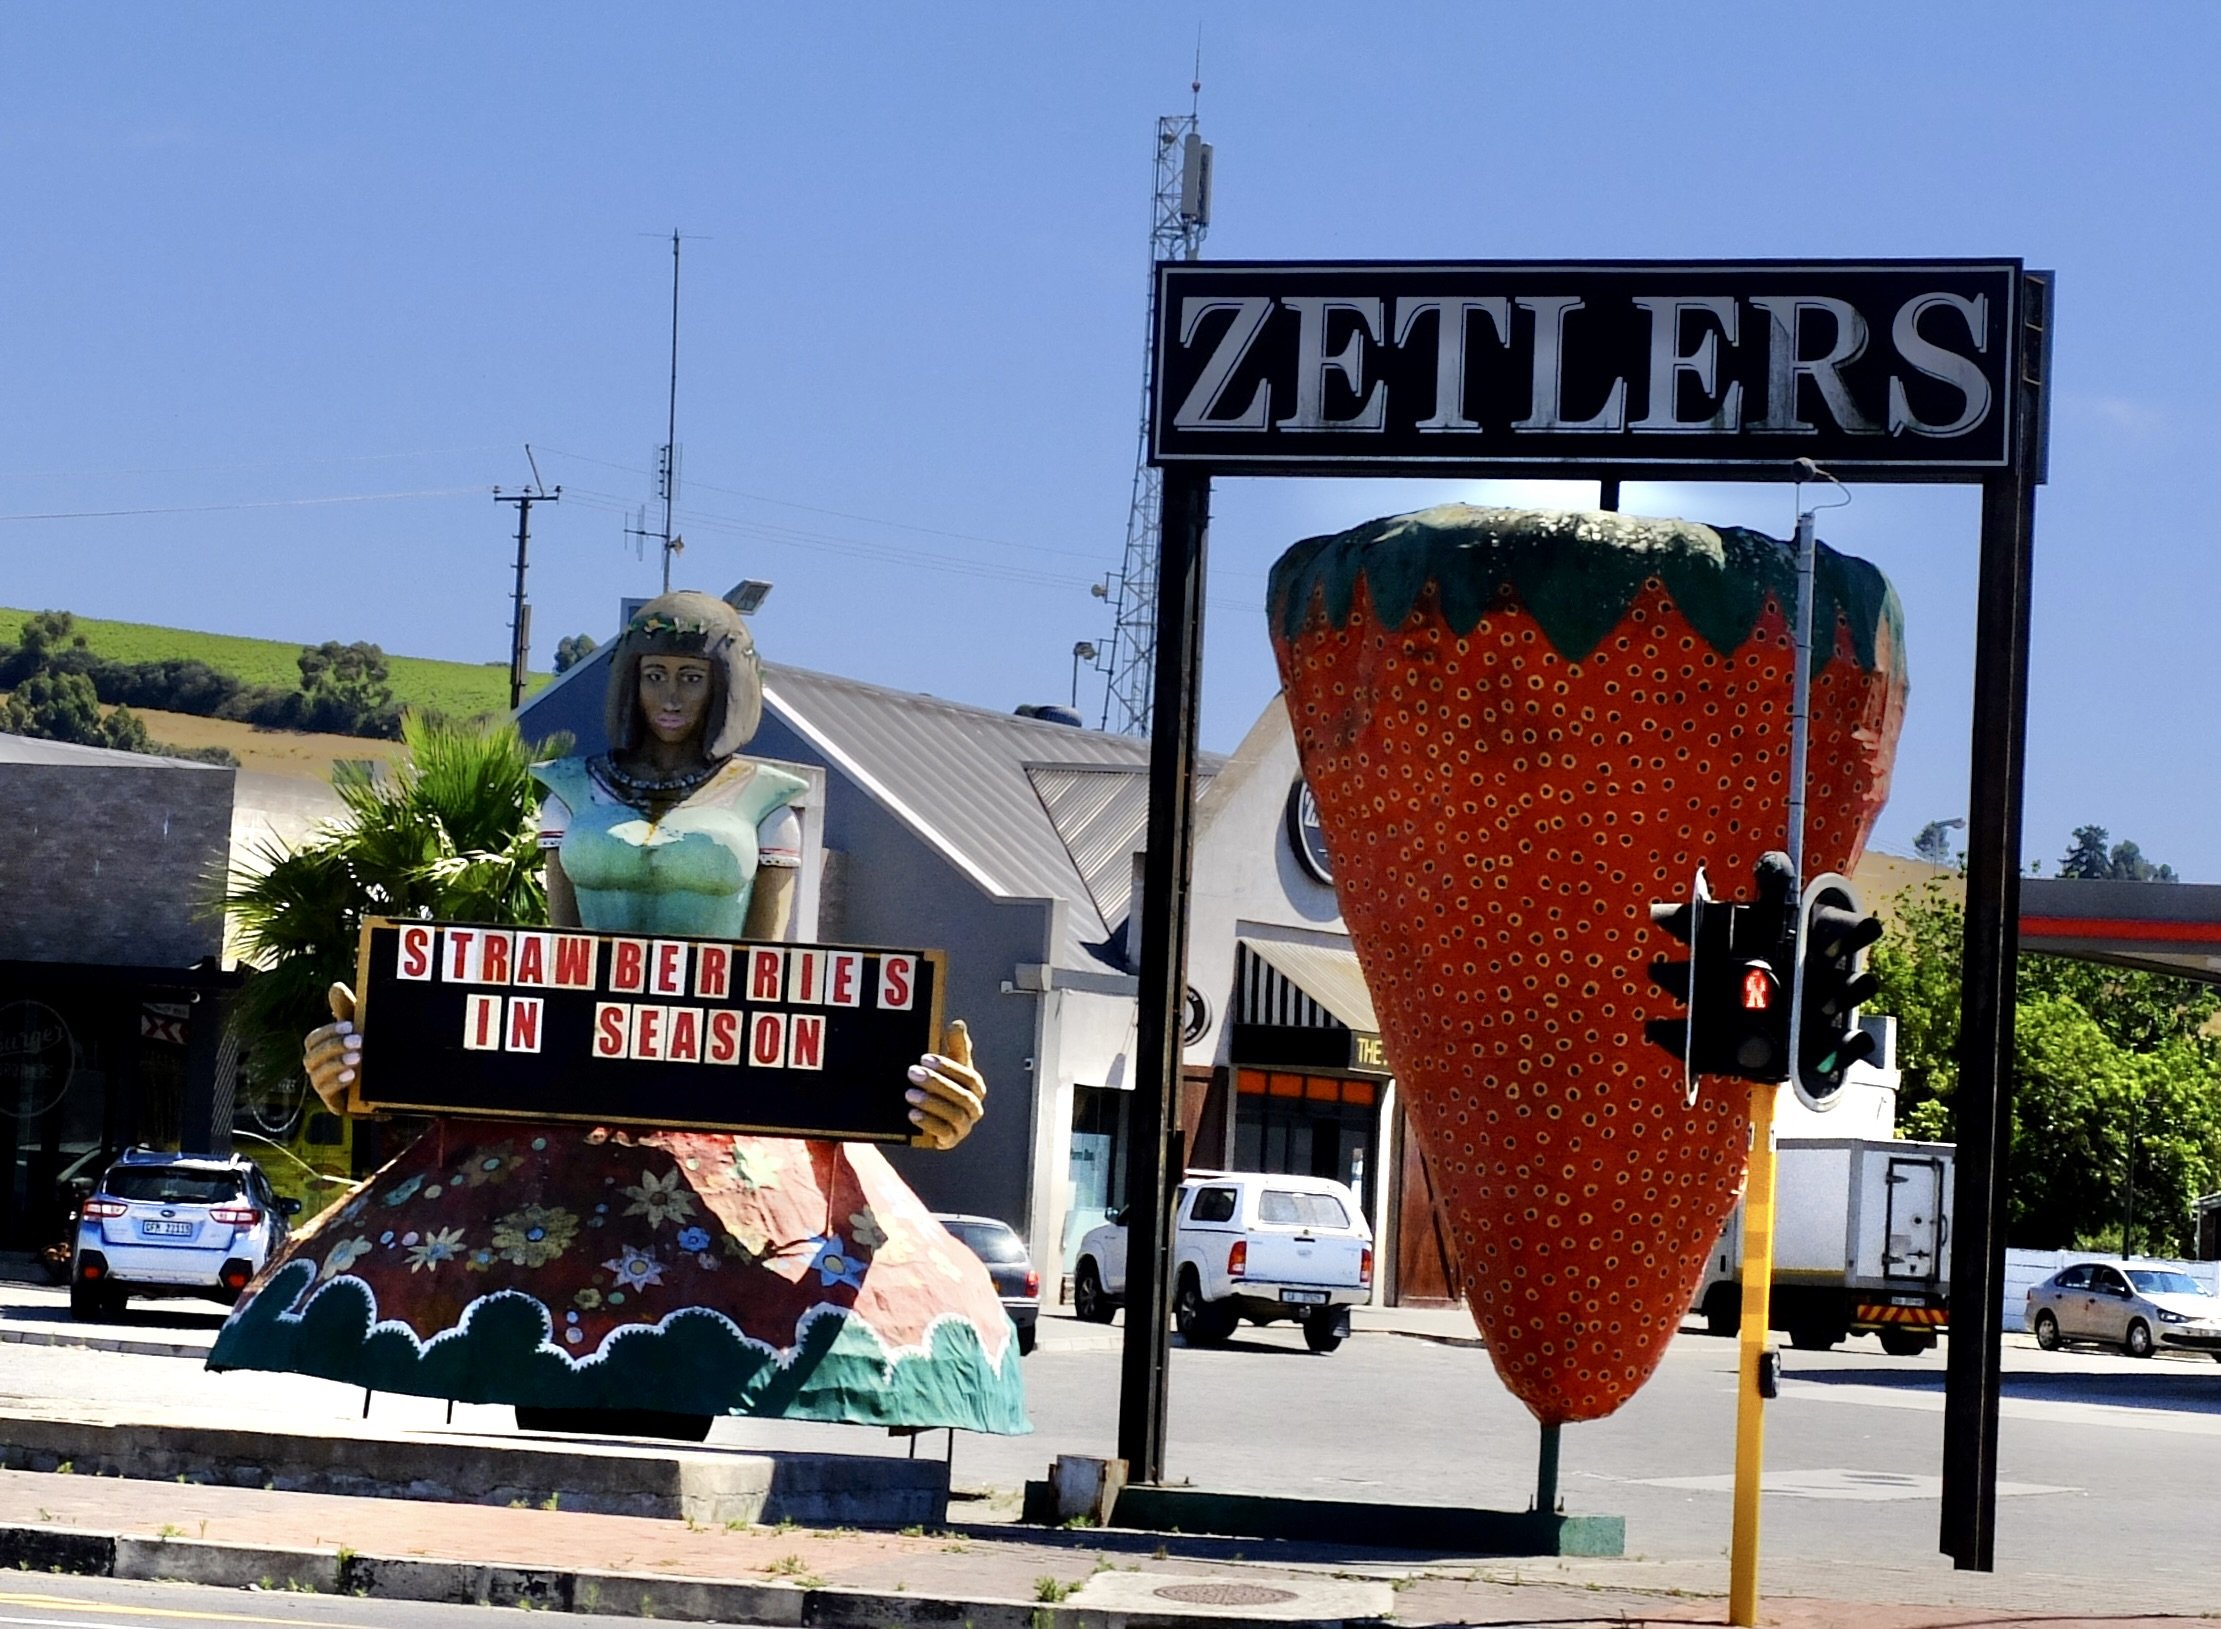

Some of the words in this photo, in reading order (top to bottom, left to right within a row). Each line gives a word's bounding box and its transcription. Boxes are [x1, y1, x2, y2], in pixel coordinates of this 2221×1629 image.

[1174, 292, 1992, 437] ZETLERS
[404, 928, 909, 1006] STRAWBERRIES
[476, 998, 538, 1050] IN
[599, 1006, 824, 1067] SEASON
[1356, 1037, 1384, 1066] THE
